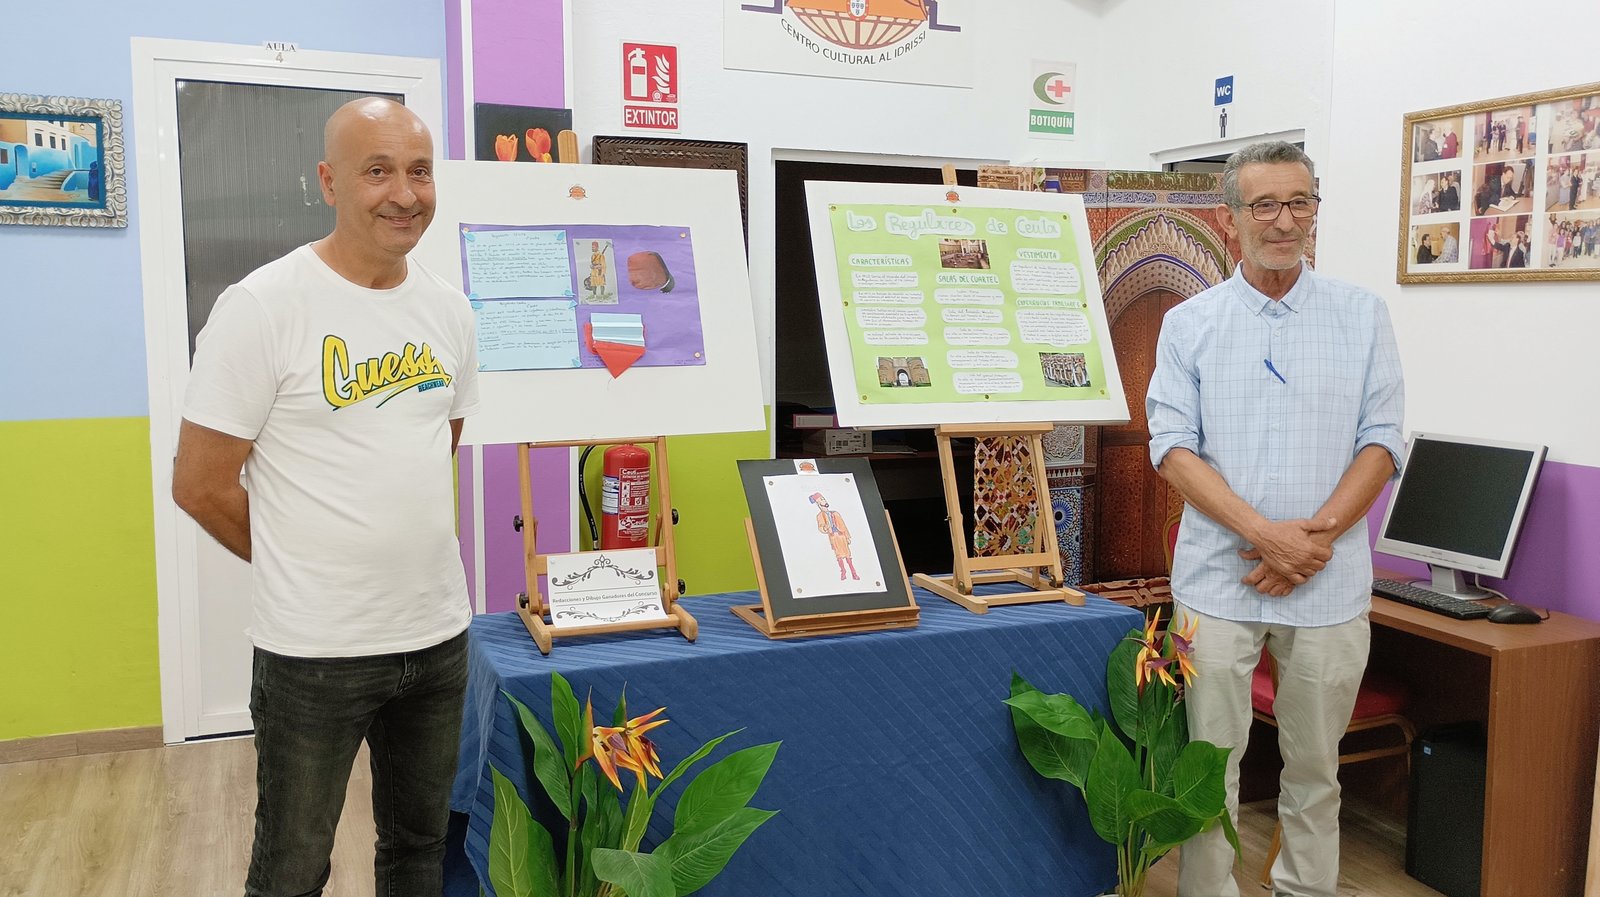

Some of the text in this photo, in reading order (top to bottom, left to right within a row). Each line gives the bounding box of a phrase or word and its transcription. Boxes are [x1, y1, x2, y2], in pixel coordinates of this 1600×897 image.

[265, 42, 297, 52] AULA
[781, 18, 926, 65] CENTRO CULTURAL AL IDRISSI
[275, 52, 284, 63] 4
[1216, 84, 1232, 98] WC
[625, 108, 677, 126] EXTINTOR
[1030, 114, 1073, 128] BOTIQUÍN
[986, 218, 1007, 233] de
[1016, 218, 1059, 235] Ceuta
[851, 256, 910, 266] CARACTERÍSTICAS
[1018, 251, 1057, 259] VESTIMENTA
[938, 274, 999, 284] SALAS DEL CUARTEL
[322, 334, 450, 409] Guess
[552, 596, 582, 604] Redacciones
